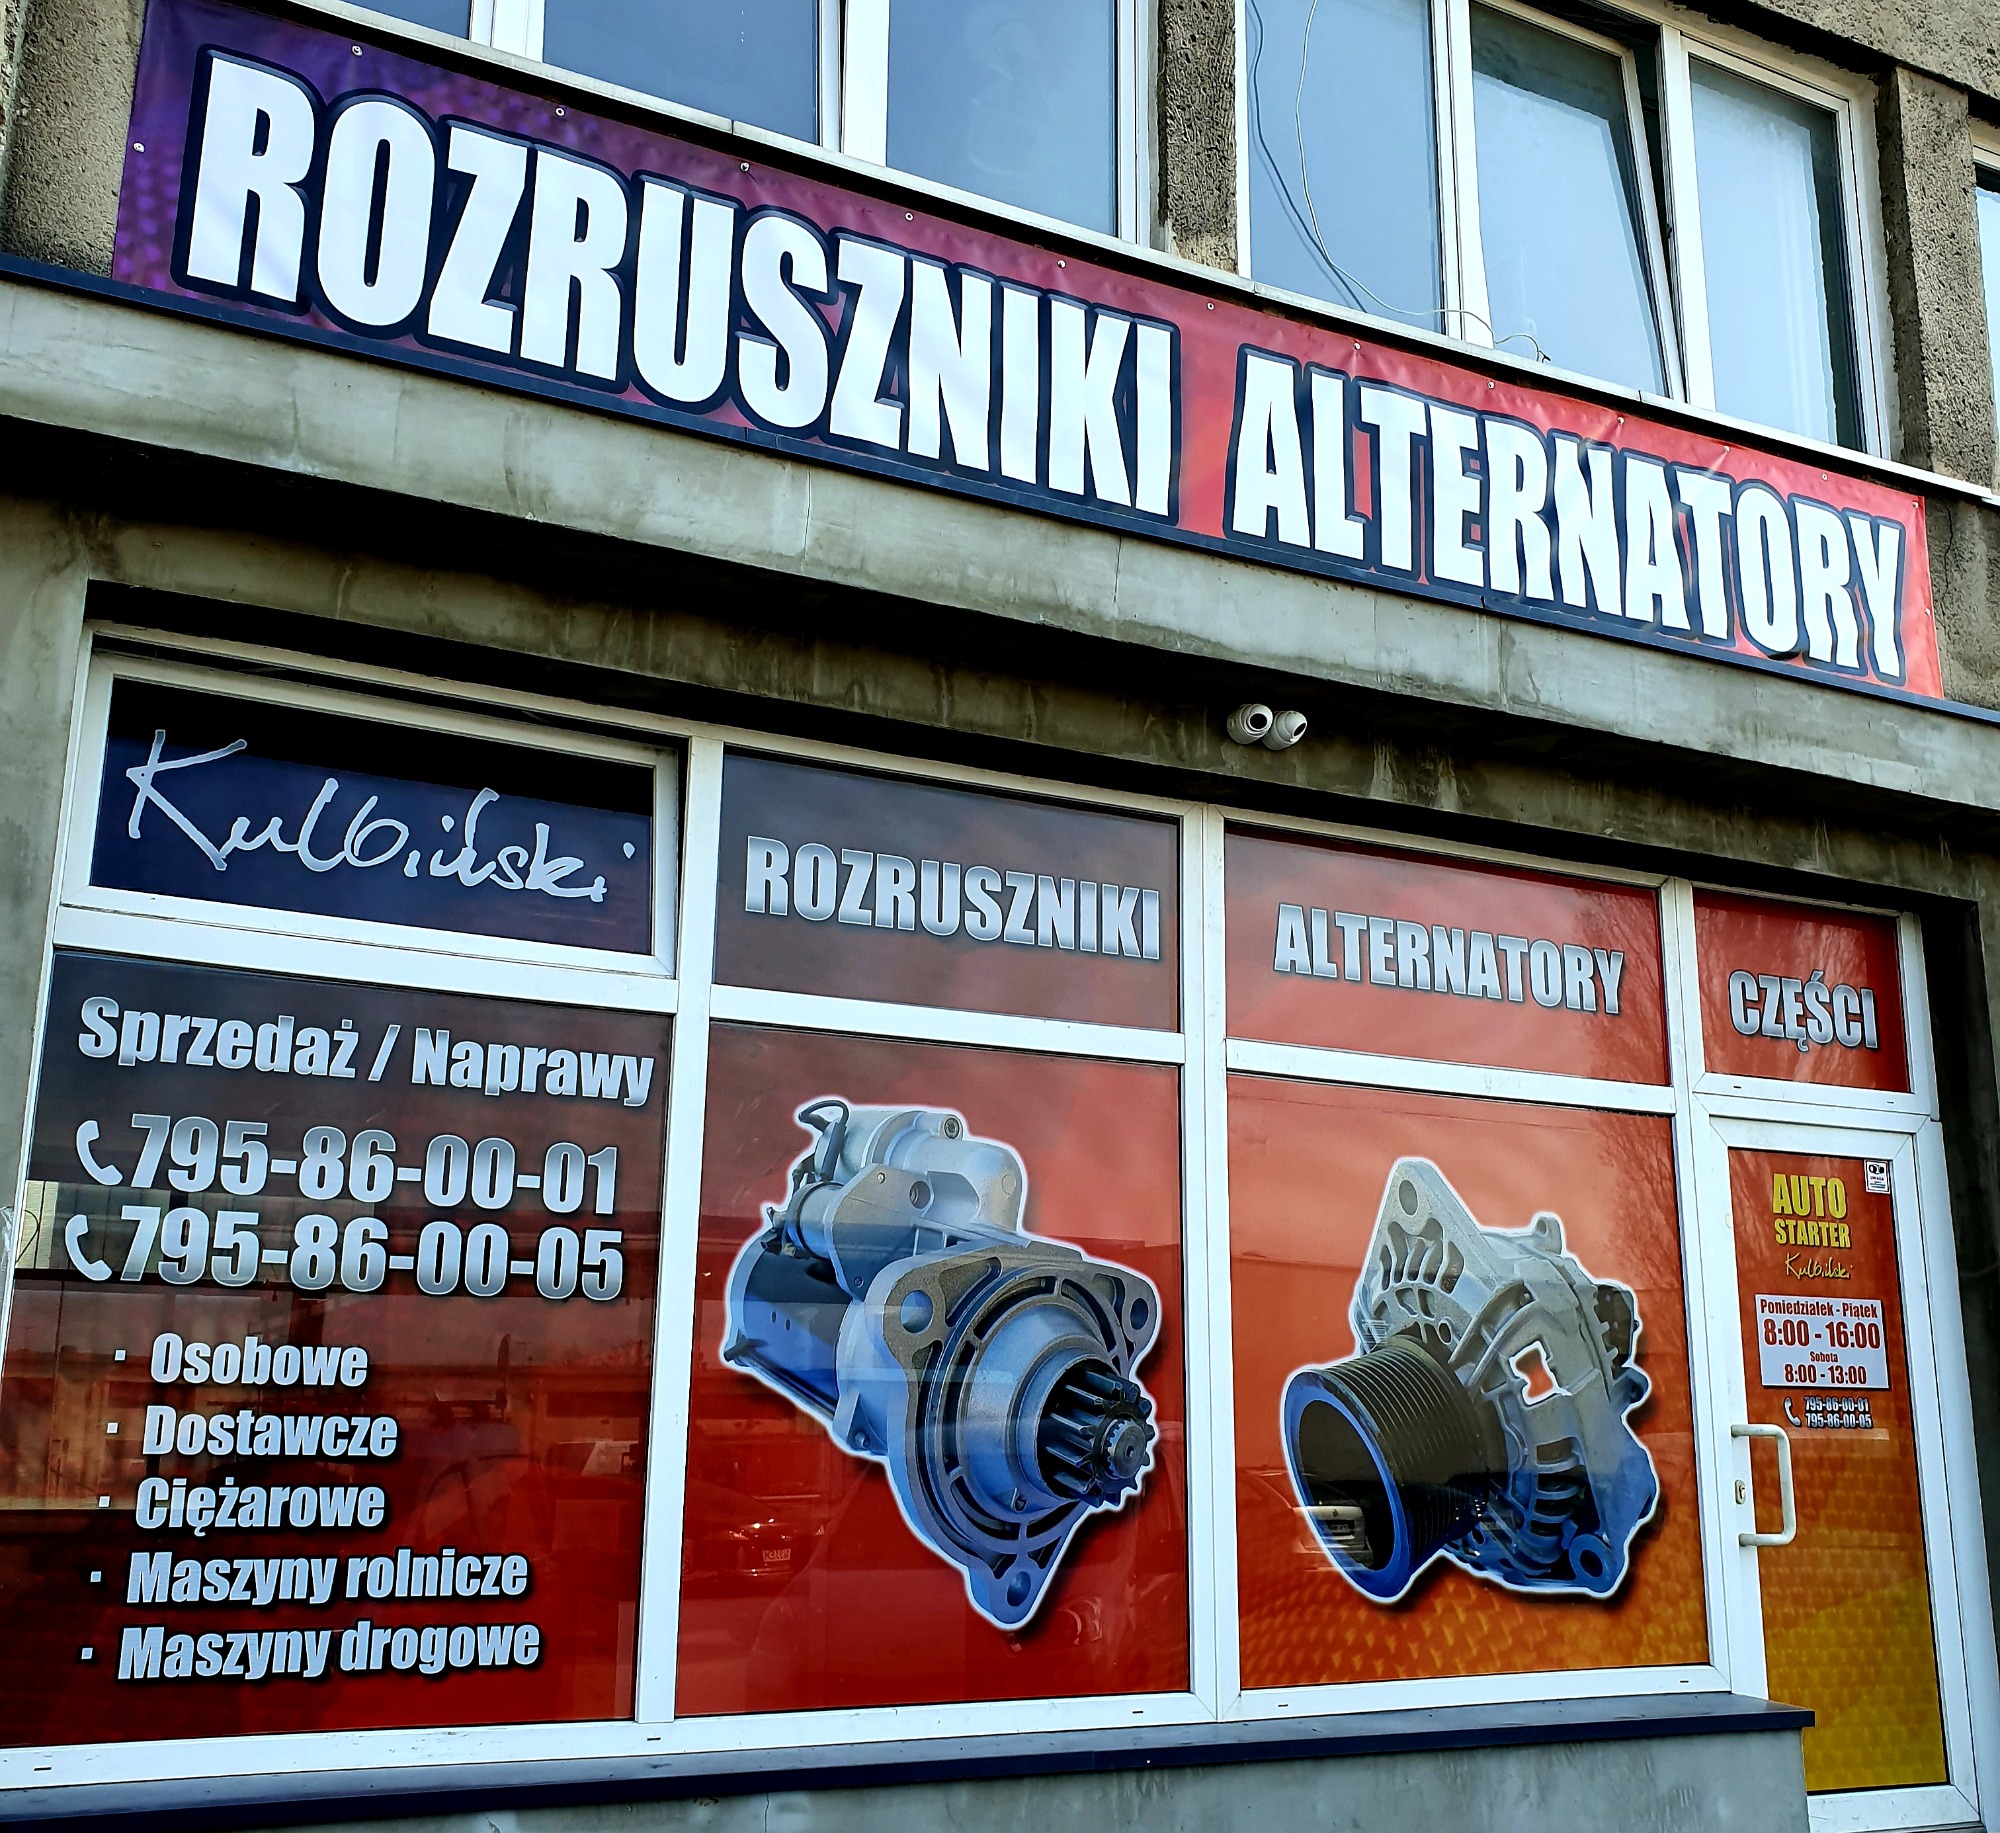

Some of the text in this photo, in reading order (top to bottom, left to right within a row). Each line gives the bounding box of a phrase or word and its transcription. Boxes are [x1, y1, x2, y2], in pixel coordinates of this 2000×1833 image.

[187, 50, 1901, 678] ROZRUSZNIKI ALTERNATORY
[745, 836, 1161, 960] ROZRUSZNIKI
[1273, 903, 1625, 1015] ALTERNATORY
[1728, 970, 1879, 1053] CZĘŚCI
[78, 996, 655, 1107] Sprzedaż / Naprawy
[129, 1113, 619, 1216] 795-86-00-01
[1772, 1173, 1847, 1219] AUTO
[119, 1205, 624, 1301] 795-86-00-05
[1774, 1218, 1851, 1248] STARTER
[1764, 1318, 1810, 1346] 8:00
[1825, 1321, 1881, 1349] 16:00
[1842, 1302, 1878, 1320] Piątek
[150, 1332, 368, 1387] Osobowe
[1784, 1364, 1817, 1383] 8:00
[1828, 1365, 1867, 1384] 13:00
[1810, 1351, 1838, 1363] Sobota
[142, 1404, 398, 1458] Dostawcze
[1804, 1396, 1869, 1412] 795-86-00-01
[1805, 1413, 1872, 1428] 795-86-00-05
[135, 1477, 385, 1536] Ciężarowe
[126, 1548, 528, 1605] Maszyny rolnicze
[117, 1620, 540, 1680] Maszyny drogowe
